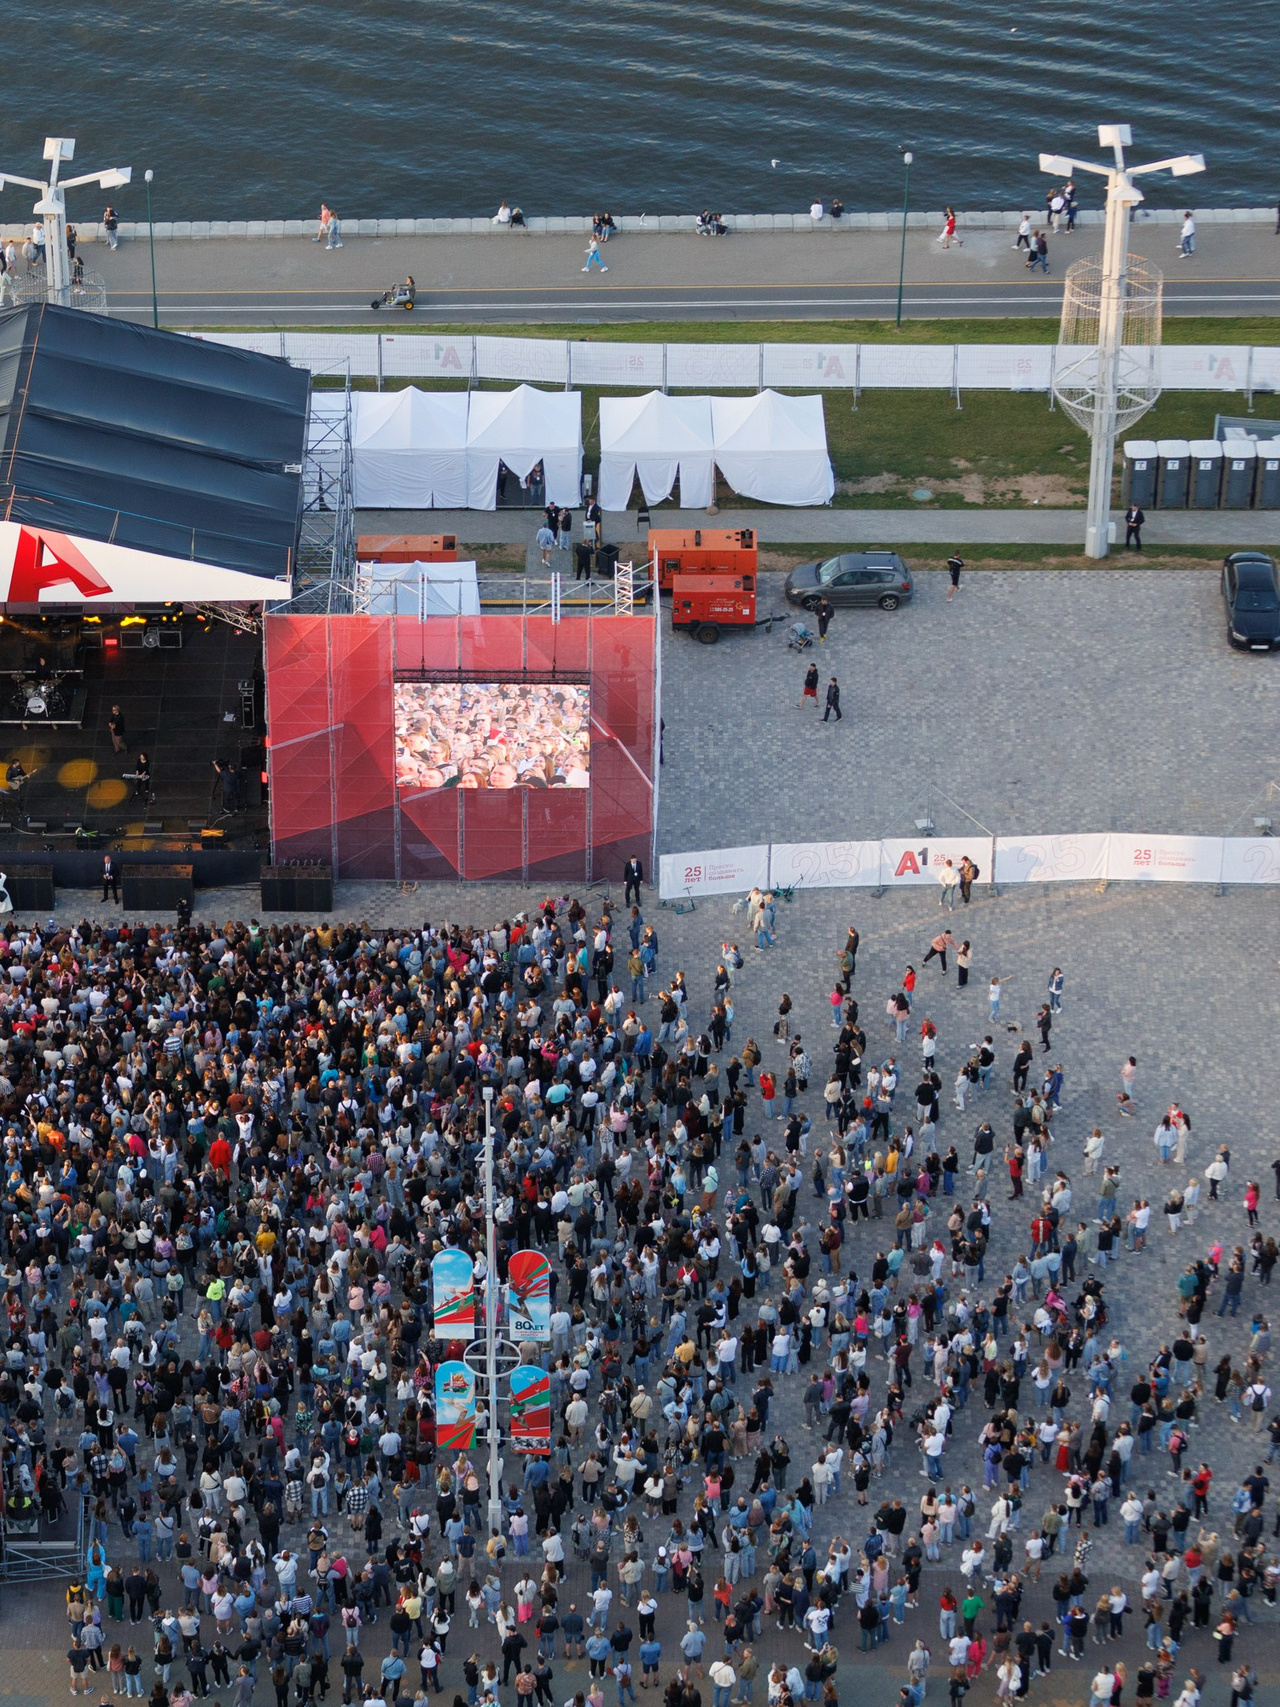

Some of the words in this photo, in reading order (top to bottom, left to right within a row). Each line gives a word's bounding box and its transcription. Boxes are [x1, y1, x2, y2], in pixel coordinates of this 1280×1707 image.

[933, 854, 946, 862] 25
[1133, 849, 1151, 860] 25
[894, 847, 928, 876] A1
[684, 866, 702, 878] 25
[515, 1321, 531, 1331] 80
